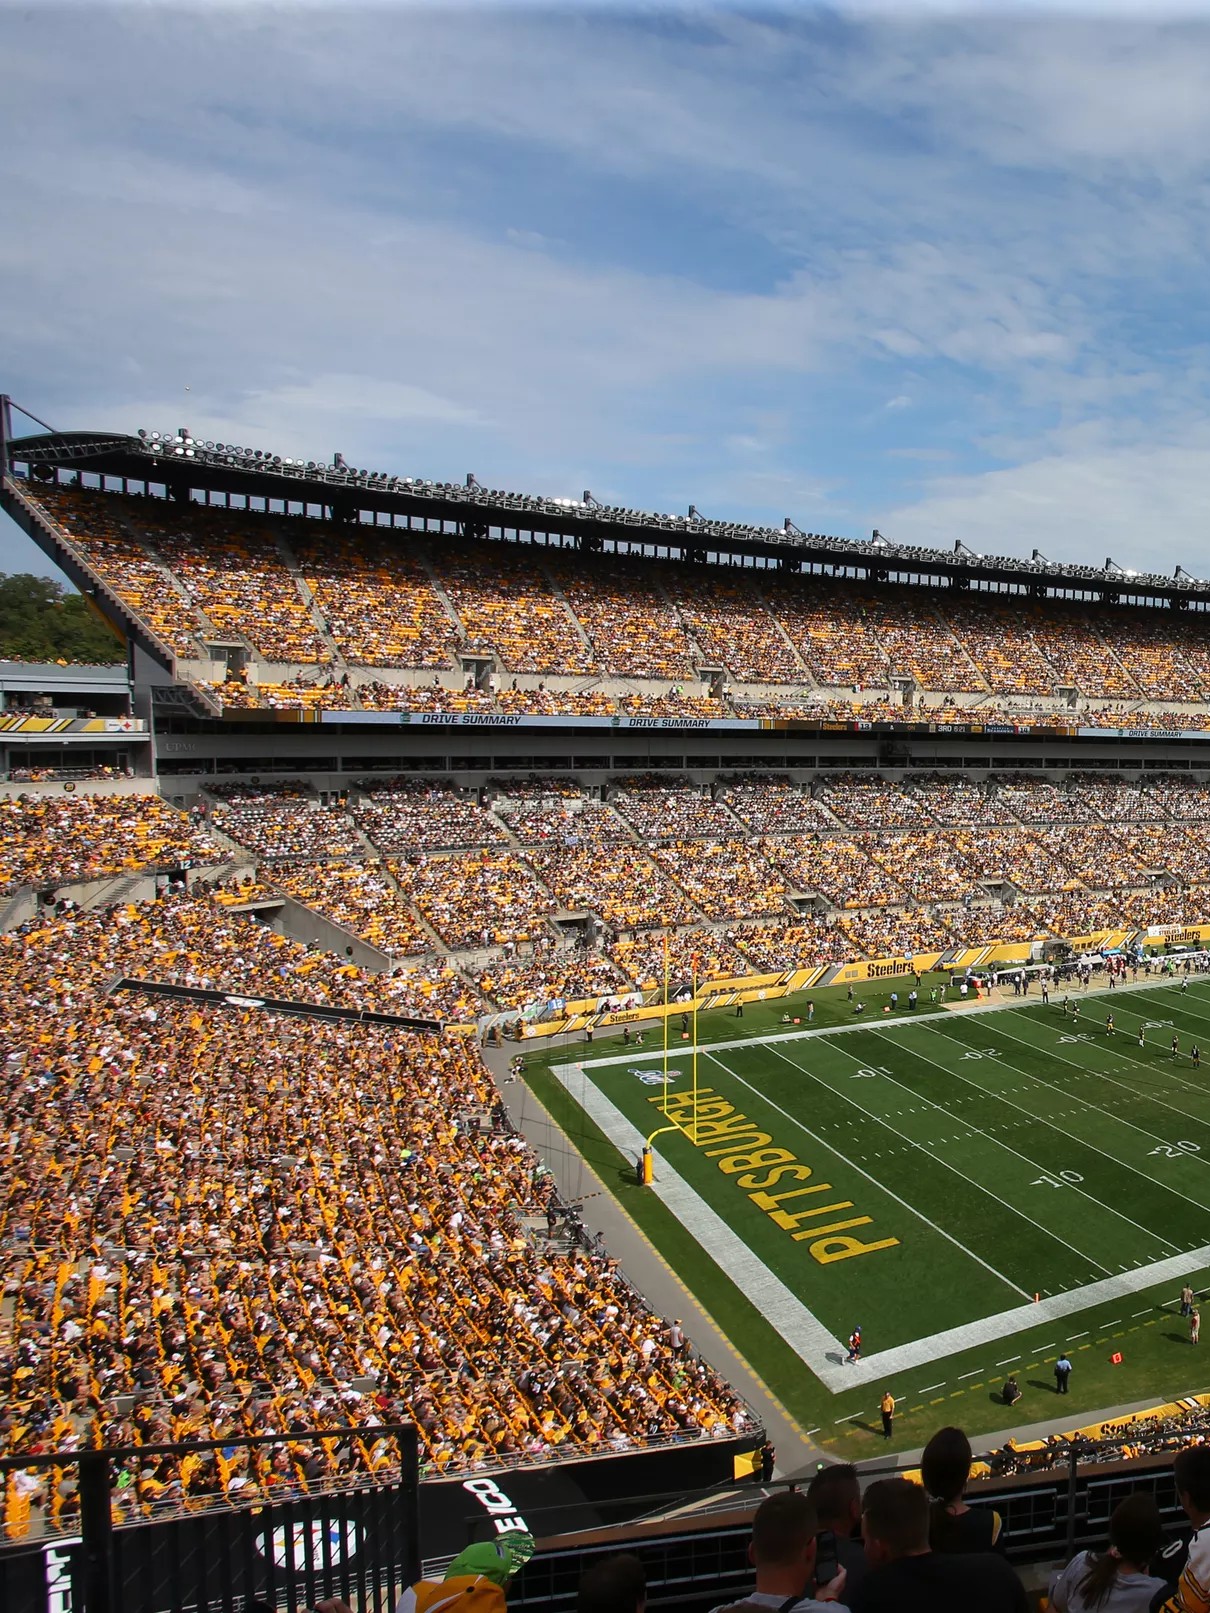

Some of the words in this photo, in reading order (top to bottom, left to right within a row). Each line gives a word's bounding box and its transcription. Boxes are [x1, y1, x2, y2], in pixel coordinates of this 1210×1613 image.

[421, 714, 459, 724] DRIVE
[461, 715, 521, 725] SUMMARY
[628, 718, 658, 727] DRIVE
[661, 718, 710, 728] SUMMARY
[860, 723, 870, 731] 13
[937, 725, 953, 733] 3RD
[867, 960, 915, 978] Steelers
[552, 1000, 564, 1010] 12
[609, 1012, 640, 1023] Steelers
[966, 1047, 1003, 1060] 20
[858, 1065, 893, 1079] 10
[1154, 1140, 1201, 1158] 20
[647, 1087, 901, 1265] PITTSBURGH
[1039, 1170, 1085, 1188] 10
[463, 1478, 531, 1535] EICO
